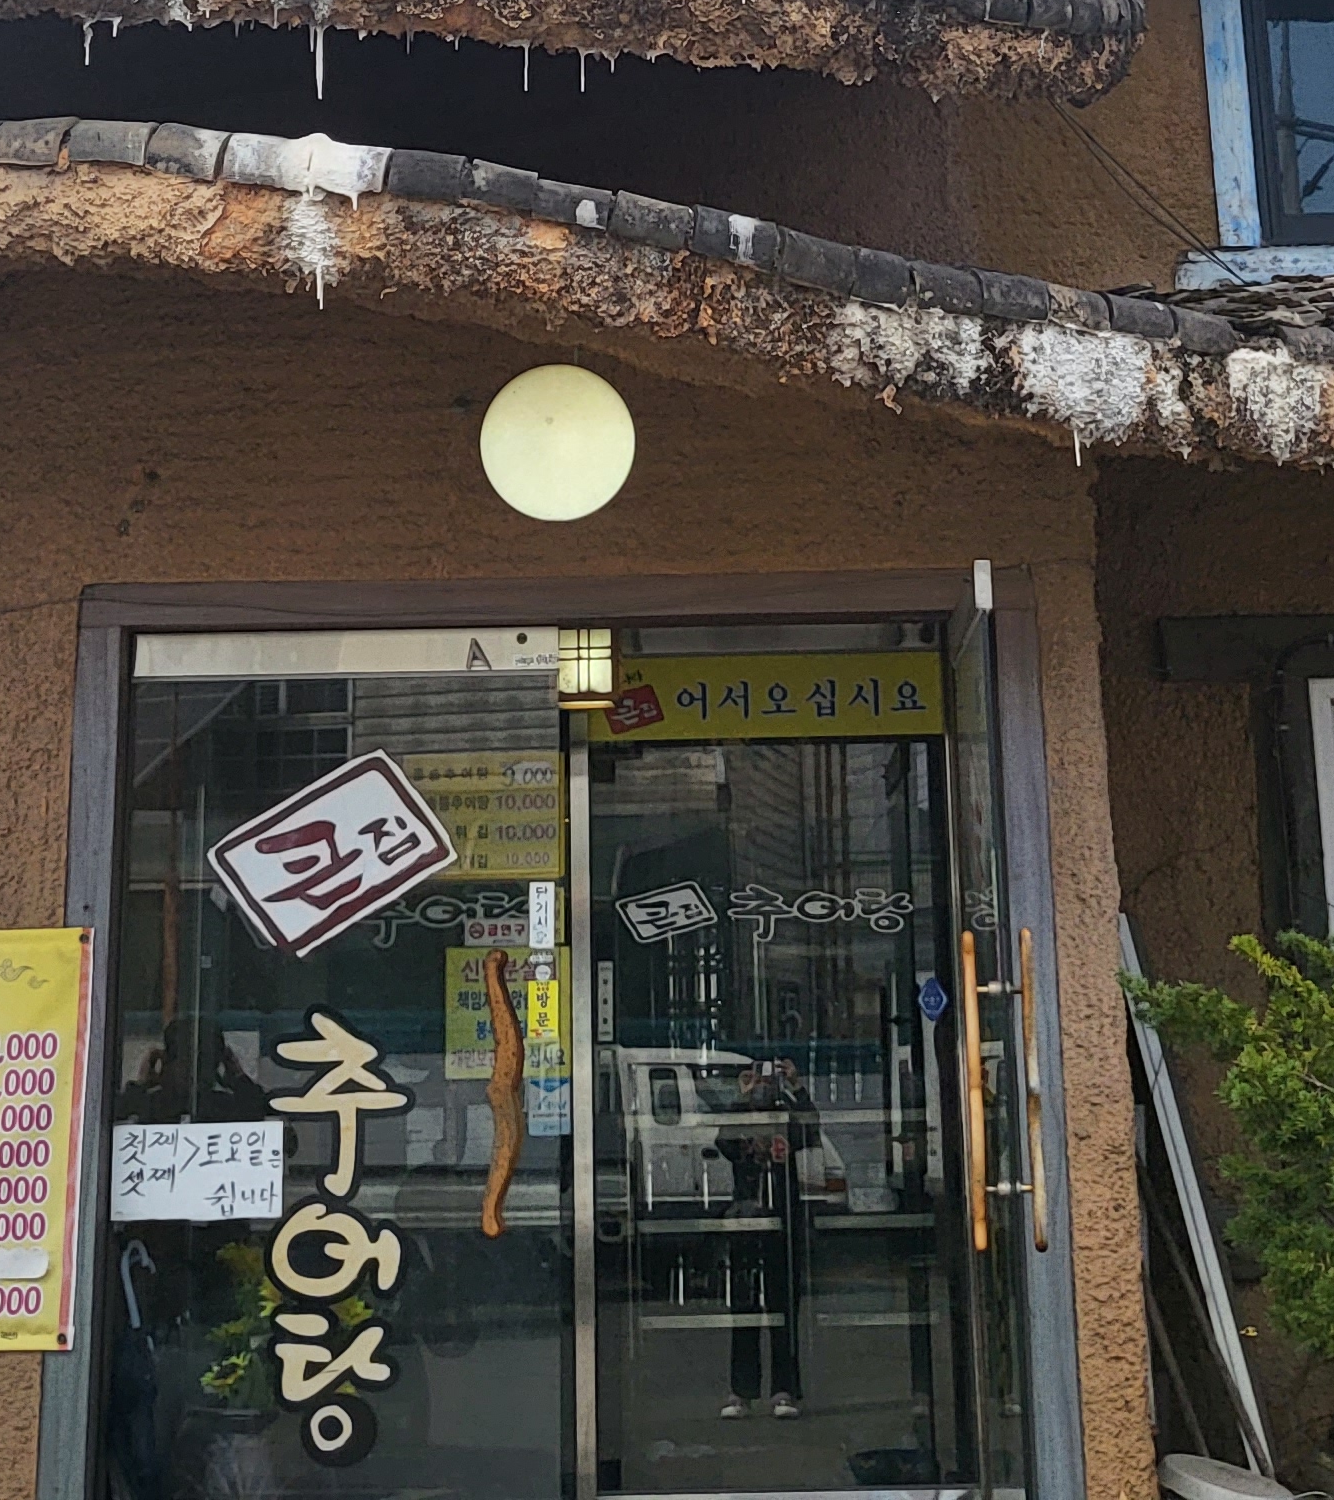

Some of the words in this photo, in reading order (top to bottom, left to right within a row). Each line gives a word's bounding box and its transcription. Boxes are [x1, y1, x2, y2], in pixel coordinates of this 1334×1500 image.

[676, 678, 927, 720] 어서오십시요
[254, 815, 420, 910] 큰집
[487, 923, 526, 937] 금연구
[727, 883, 914, 942] 추어탕
[119, 1128, 179, 1166] 첫째
[198, 1130, 282, 1169] 토요일은
[203, 1181, 279, 1218] 쉽니다
[265, 1008, 413, 1467] 추어탕
